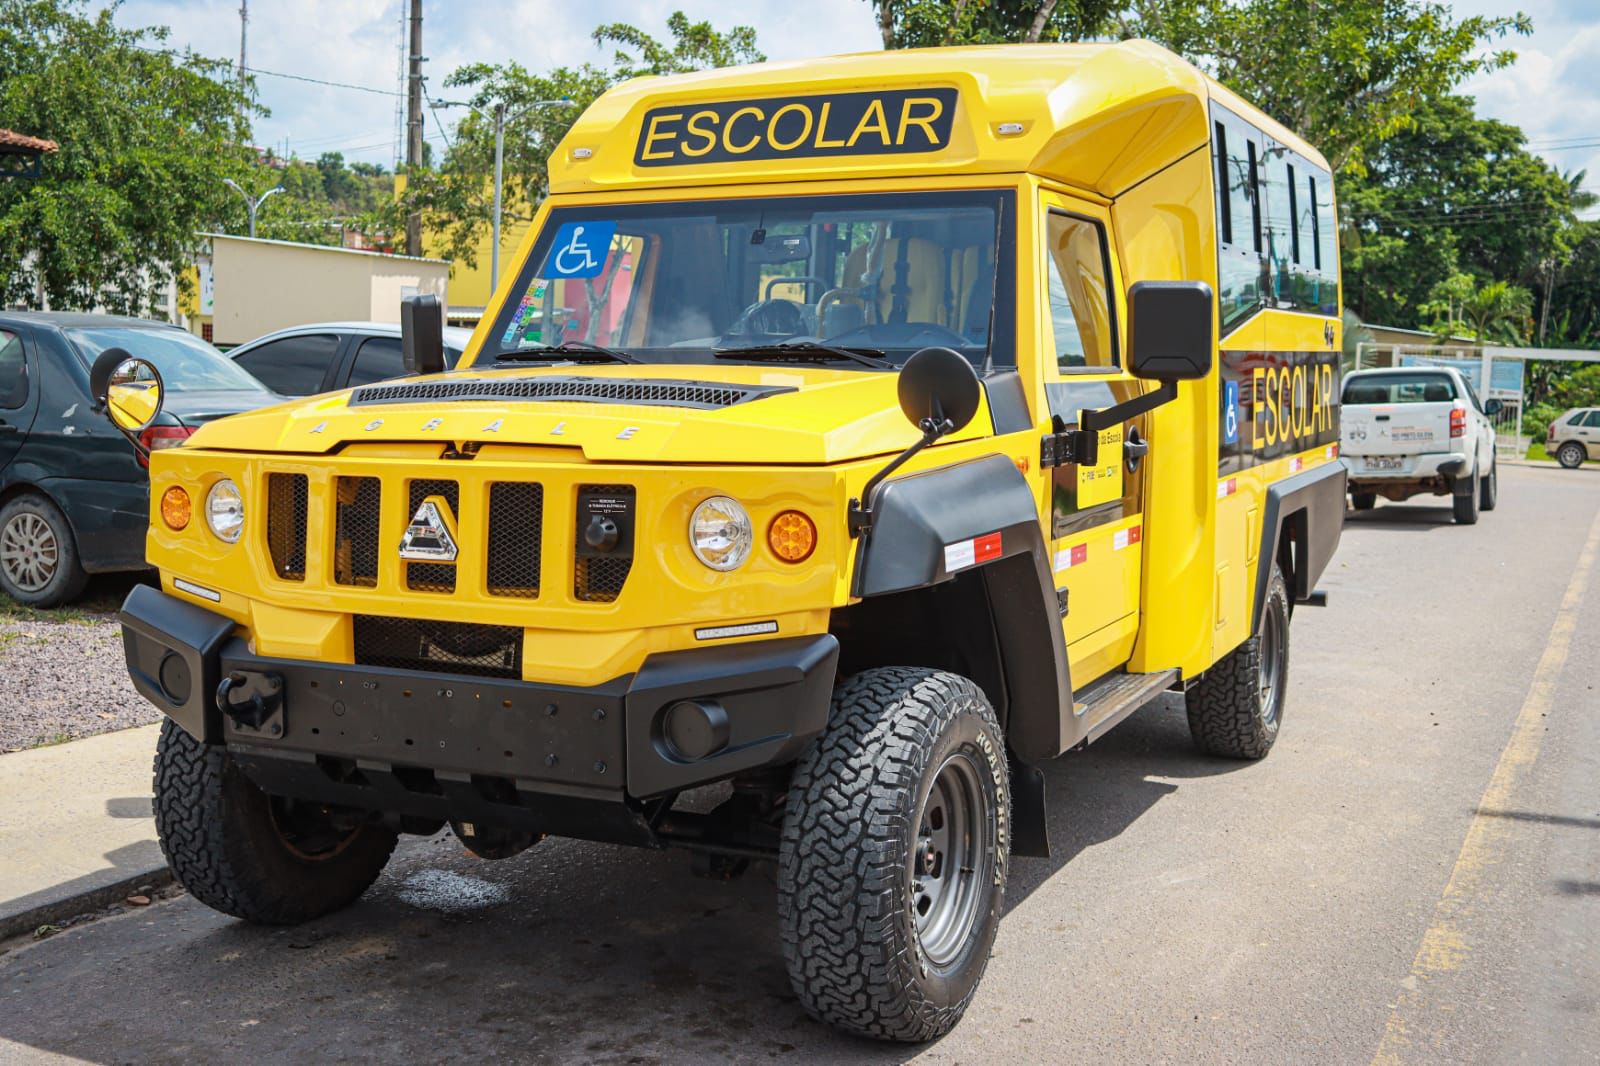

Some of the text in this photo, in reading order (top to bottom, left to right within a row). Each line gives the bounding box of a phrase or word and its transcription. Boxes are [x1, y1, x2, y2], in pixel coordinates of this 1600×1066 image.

[642, 97, 943, 161] ESCOLAR
[1252, 364, 1332, 449] ESCOLAR
[309, 418, 641, 441] AGRALE
[1107, 431, 1121, 444] Escola
